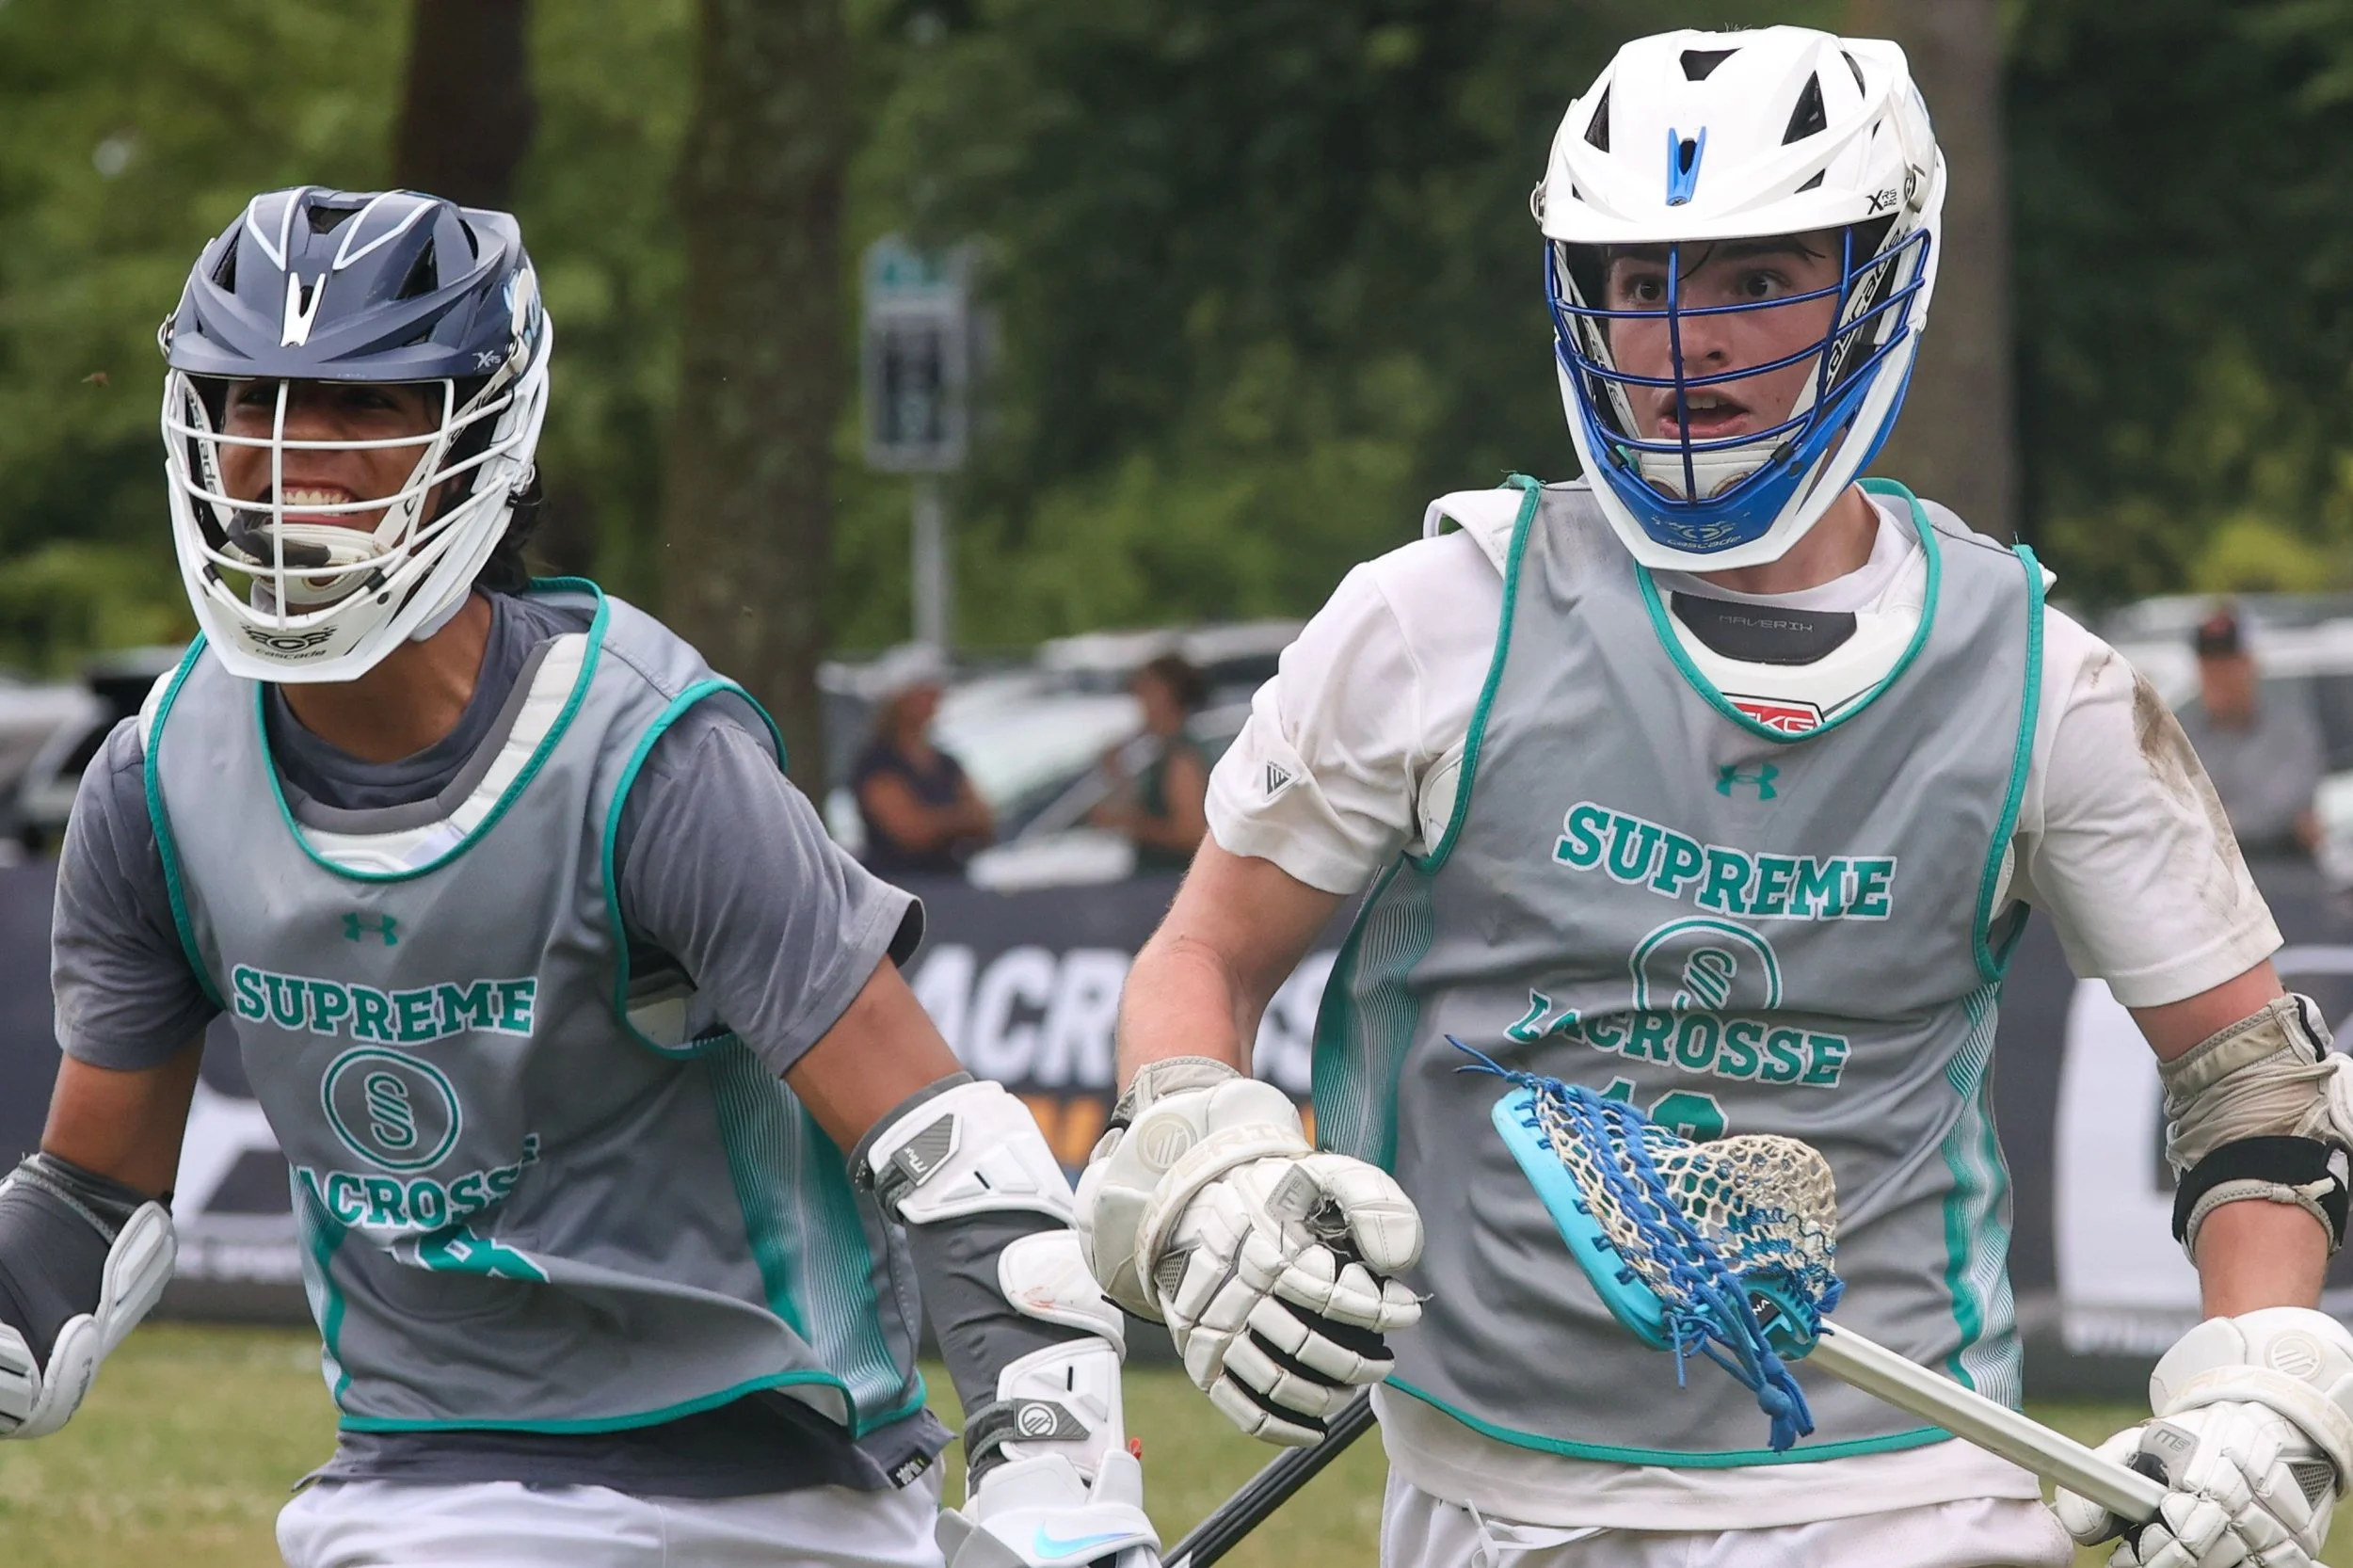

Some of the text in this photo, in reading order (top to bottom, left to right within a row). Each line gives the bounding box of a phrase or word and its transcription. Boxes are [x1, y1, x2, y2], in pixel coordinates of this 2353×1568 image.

[1719, 615, 1815, 632] MAVERIK
[1552, 801, 1897, 921] SUPREME
[231, 964, 538, 1046] SUPREME
